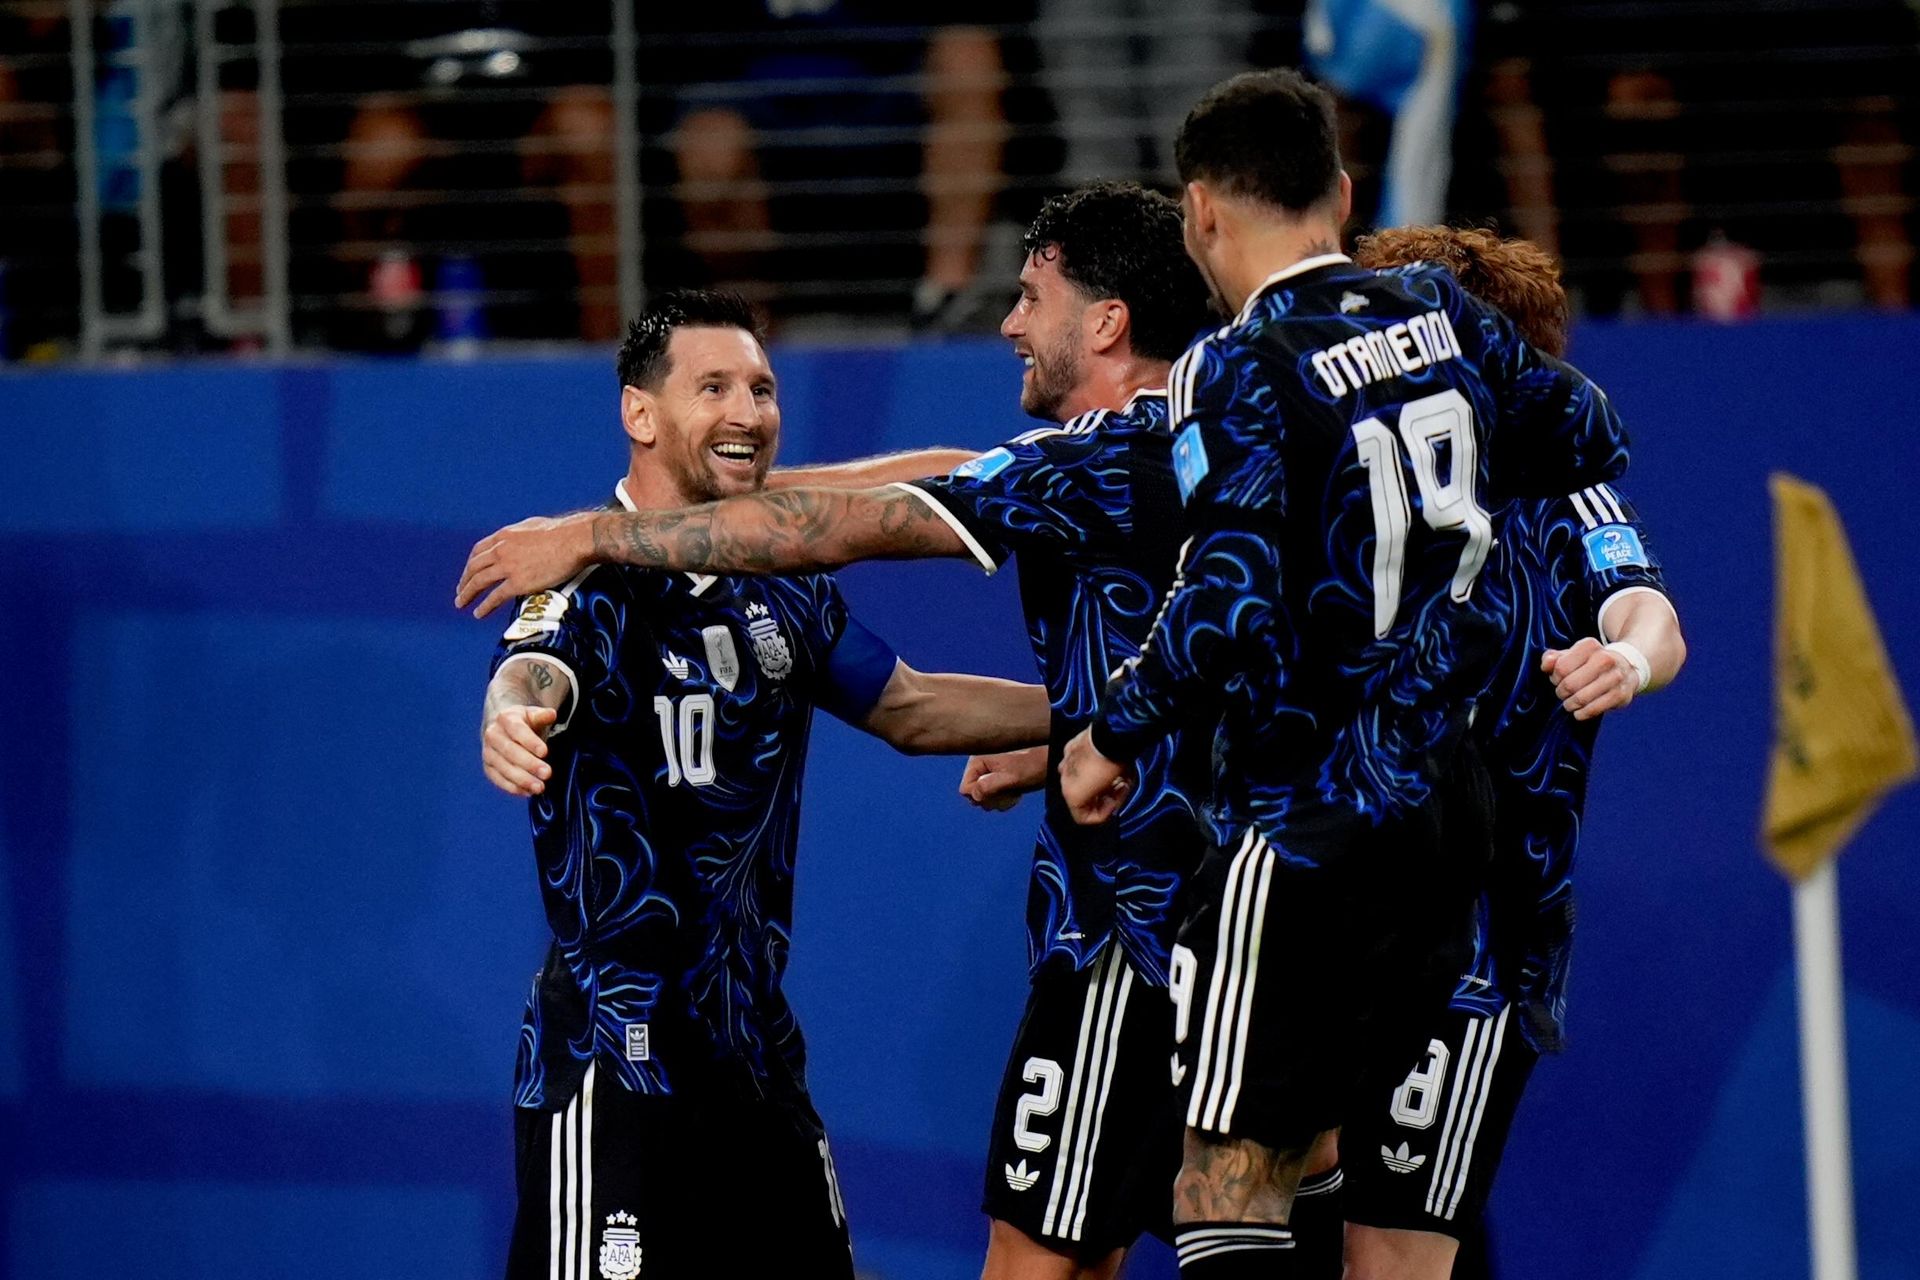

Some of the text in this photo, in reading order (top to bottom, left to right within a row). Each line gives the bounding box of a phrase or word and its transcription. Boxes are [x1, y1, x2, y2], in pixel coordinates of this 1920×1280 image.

[1312, 309, 1463, 397] OTAMENDI
[1351, 388, 1492, 641] 19
[653, 694, 717, 787] 10
[1013, 1056, 1064, 1153] 2
[1389, 1037, 1451, 1130] 8
